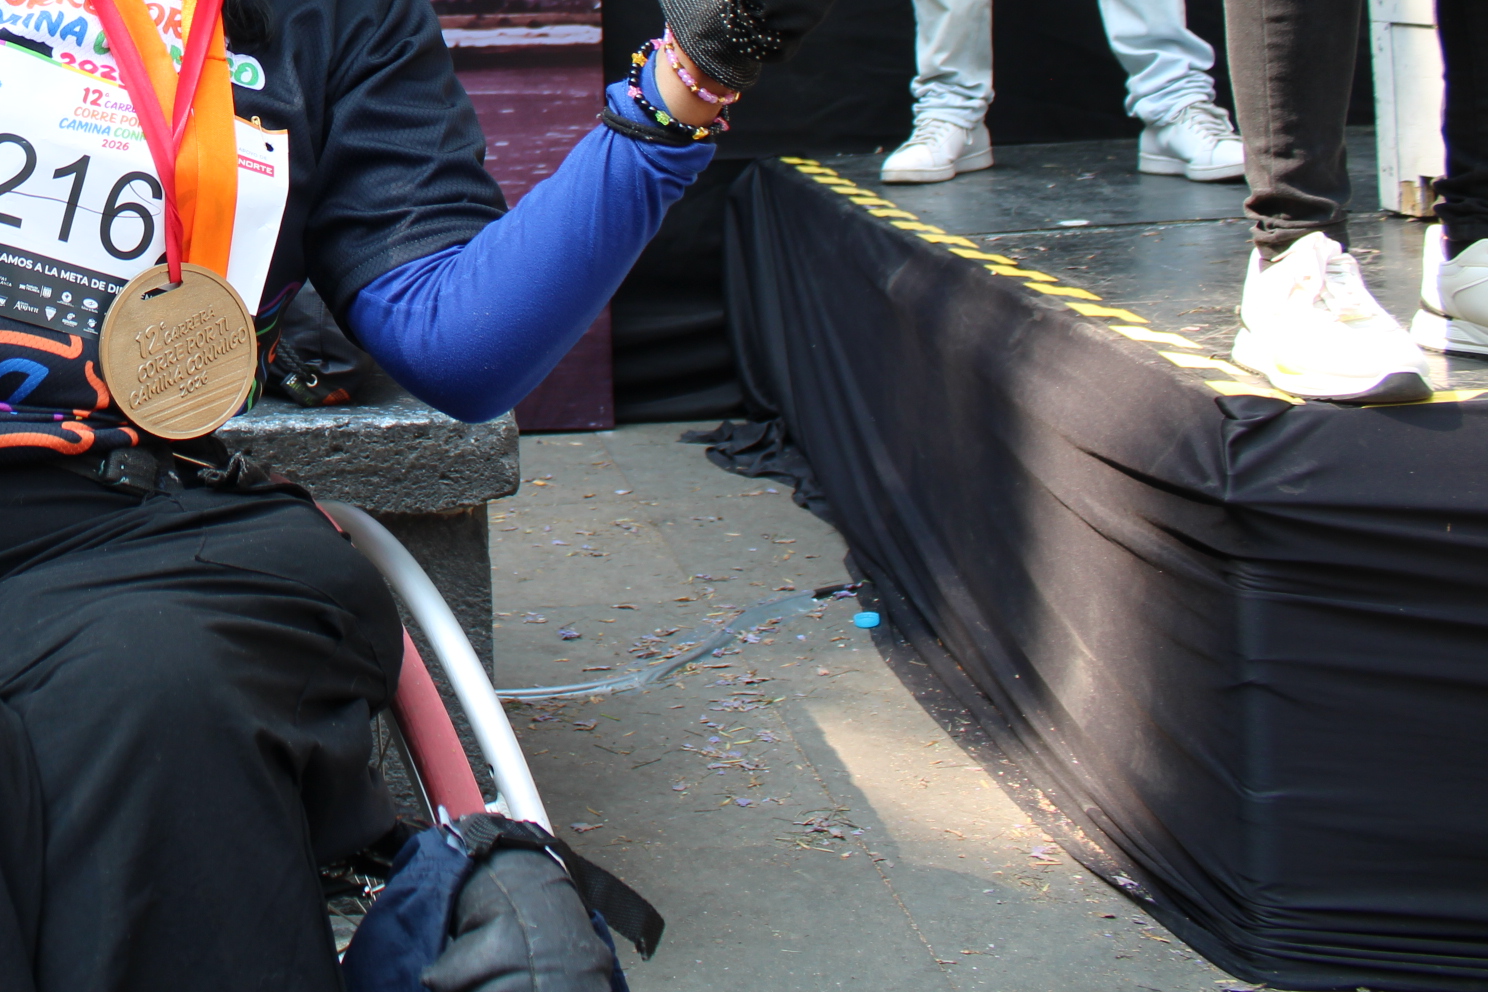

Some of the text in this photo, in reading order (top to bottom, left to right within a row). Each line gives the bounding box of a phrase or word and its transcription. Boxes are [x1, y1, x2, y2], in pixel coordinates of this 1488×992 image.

[147, 2, 183, 40] OR
[58, 117, 112, 137] CAMINA
[73, 106, 118, 124] CORRE
[101, 138, 130, 151] 2026
[238, 158, 273, 175] NORTE
[34, 262, 45, 273] A
[44, 265, 59, 278] LA
[60, 269, 89, 287] META
[90, 278, 107, 292] DE
[163, 304, 216, 346] CARRERA
[137, 316, 230, 384] CORRE POR TI
[128, 326, 248, 411] CAMINA CONMIGO
[178, 369, 210, 399] 2026
